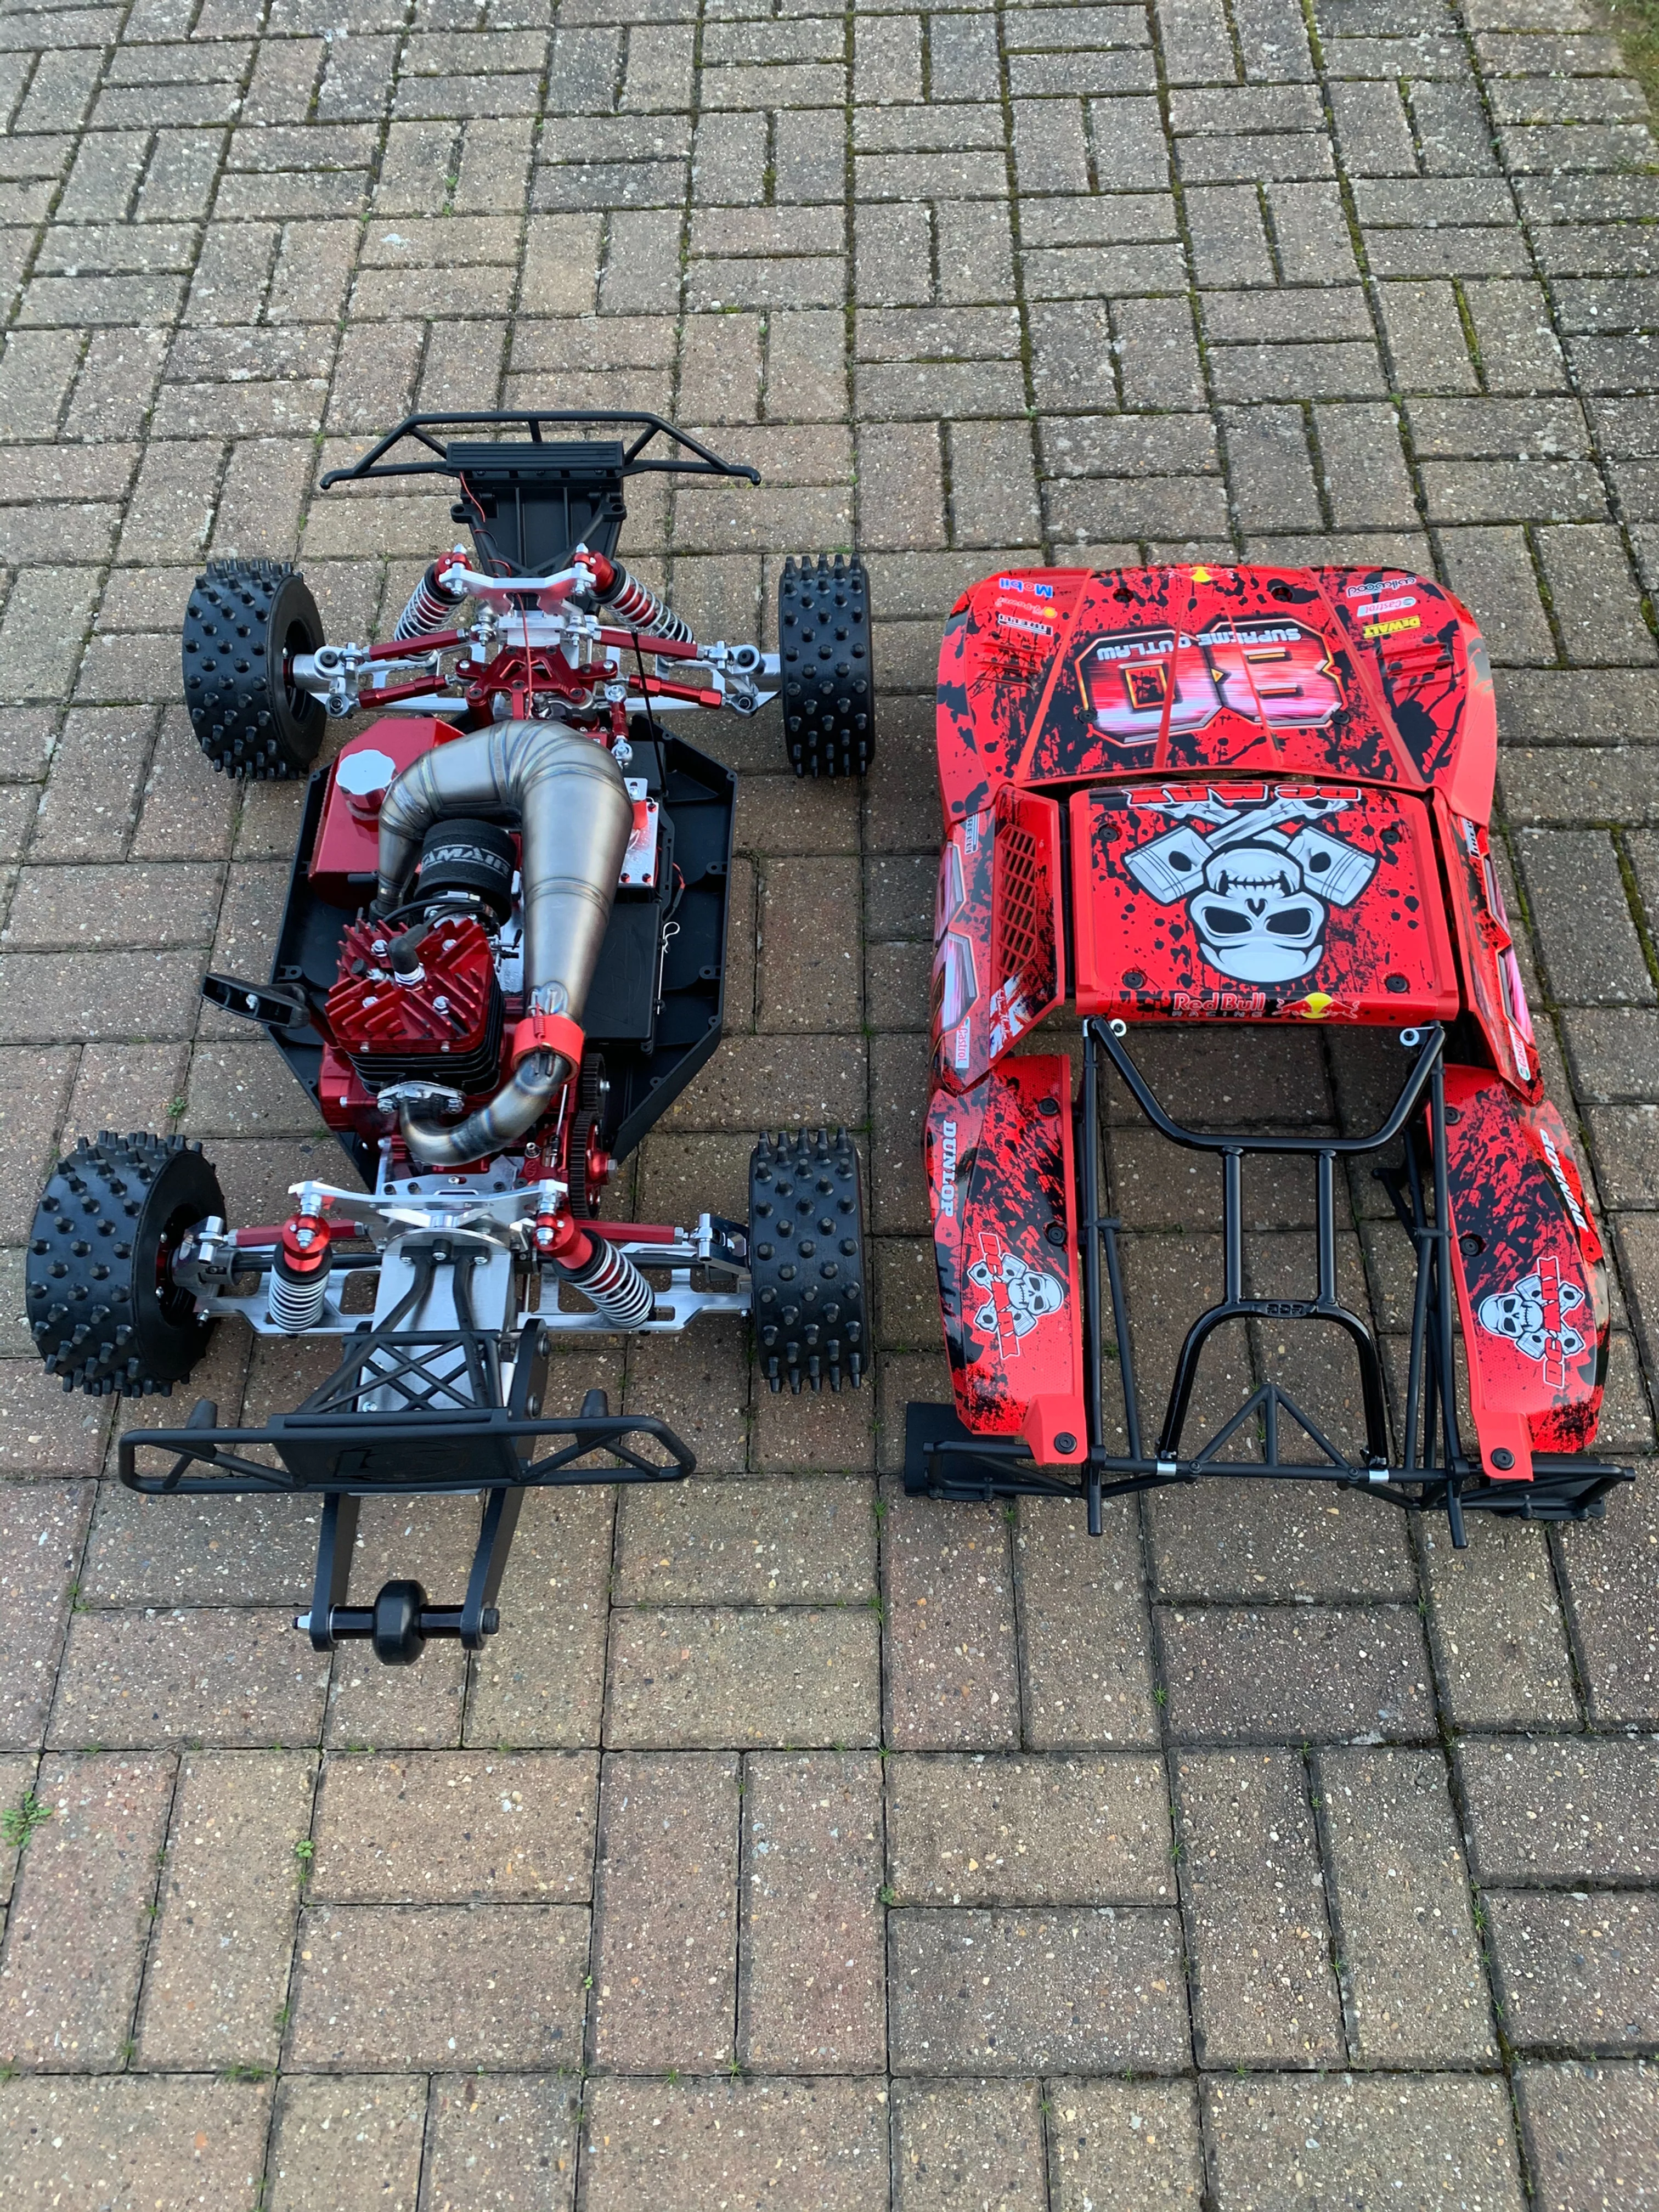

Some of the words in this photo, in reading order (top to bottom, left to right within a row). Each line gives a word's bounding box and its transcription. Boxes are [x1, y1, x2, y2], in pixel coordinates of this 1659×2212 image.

[1000, 578, 1053, 598] Mobil
[1365, 600, 1402, 614] Castrol
[1097, 636, 1192, 661] OUTLAW
[1198, 628, 1302, 646] SUPREME
[1173, 992, 1219, 1011] Red
[1221, 992, 1266, 1011] Bull
[958, 1027, 968, 1062] Castrol
[941, 1120, 957, 1217] DUNLOP
[1539, 1128, 1589, 1233] DUNLOP
[1537, 1256, 1562, 1333] MAX
[991, 1281, 1020, 1359] MAX
